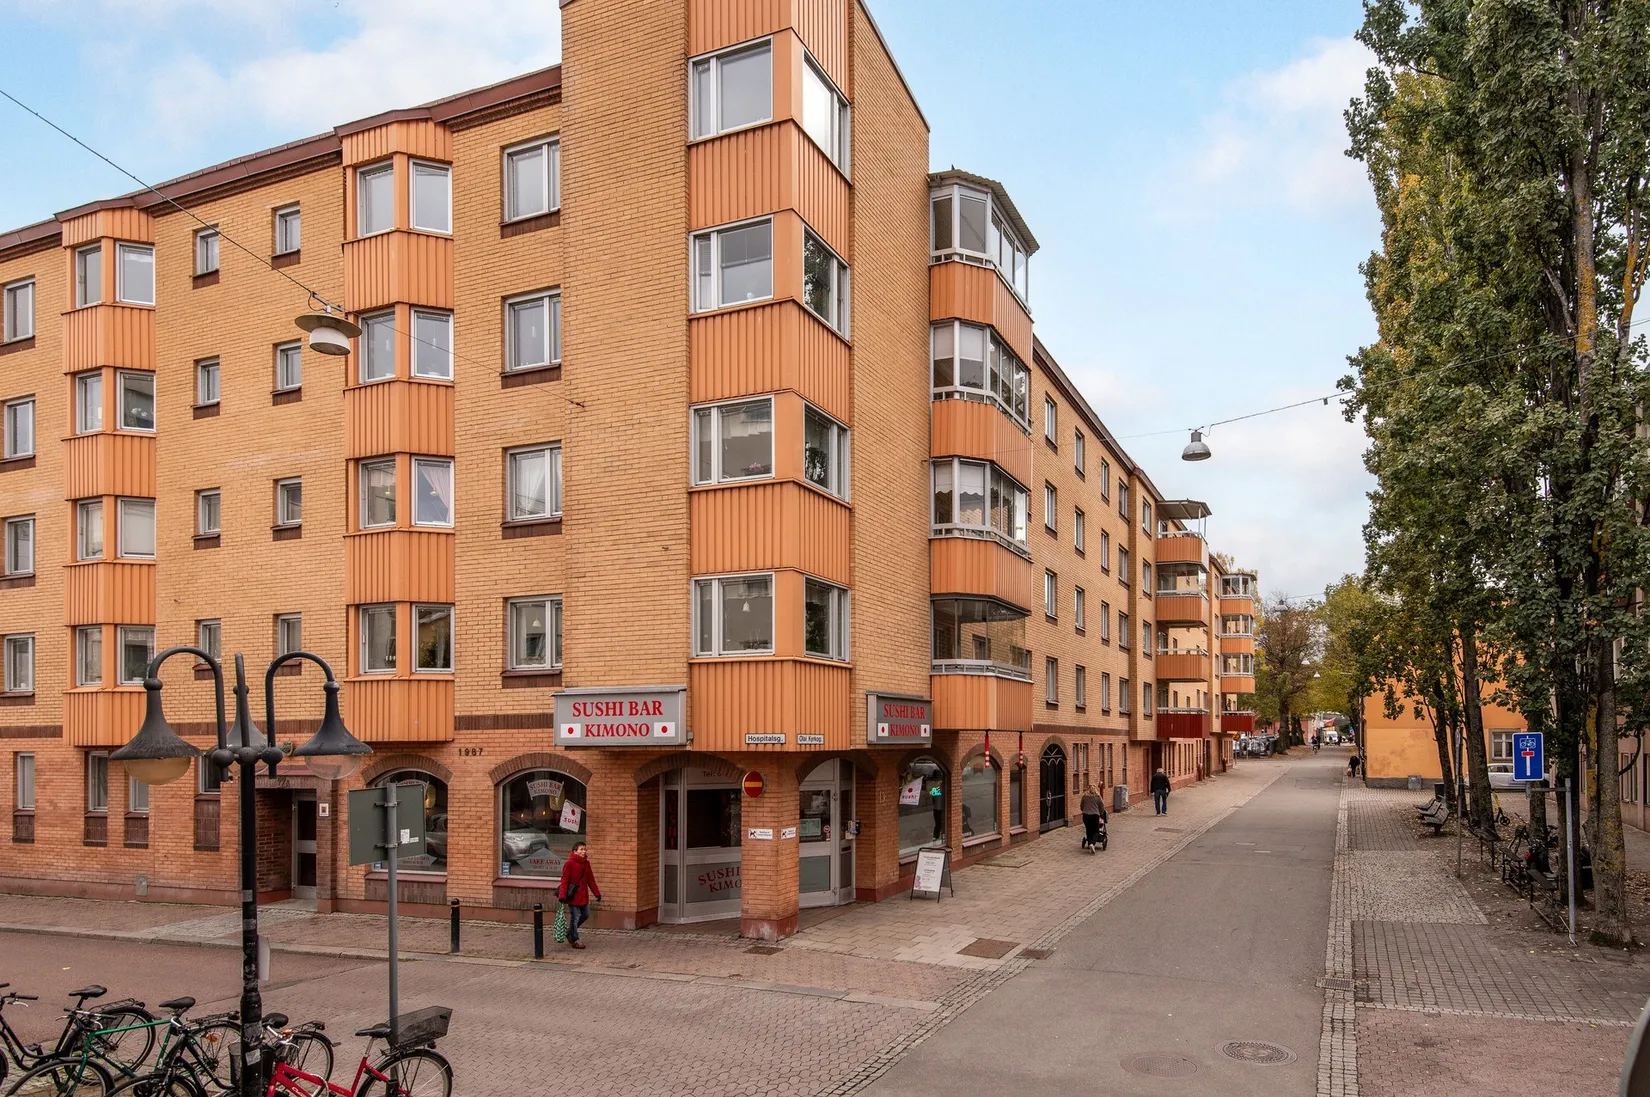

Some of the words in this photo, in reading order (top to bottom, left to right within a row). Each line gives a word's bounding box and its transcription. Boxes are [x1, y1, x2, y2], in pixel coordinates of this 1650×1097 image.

[572, 701, 624, 717] SUSHI
[628, 700, 663, 716] BAR
[884, 703, 908, 719] SUSHI
[910, 706, 926, 719] BAR
[585, 723, 650, 737] KIMONO
[890, 724, 920, 737] KIMONO
[458, 747, 484, 756] 1987
[697, 867, 740, 886] SUSHI
[709, 880, 742, 893] KIMO
